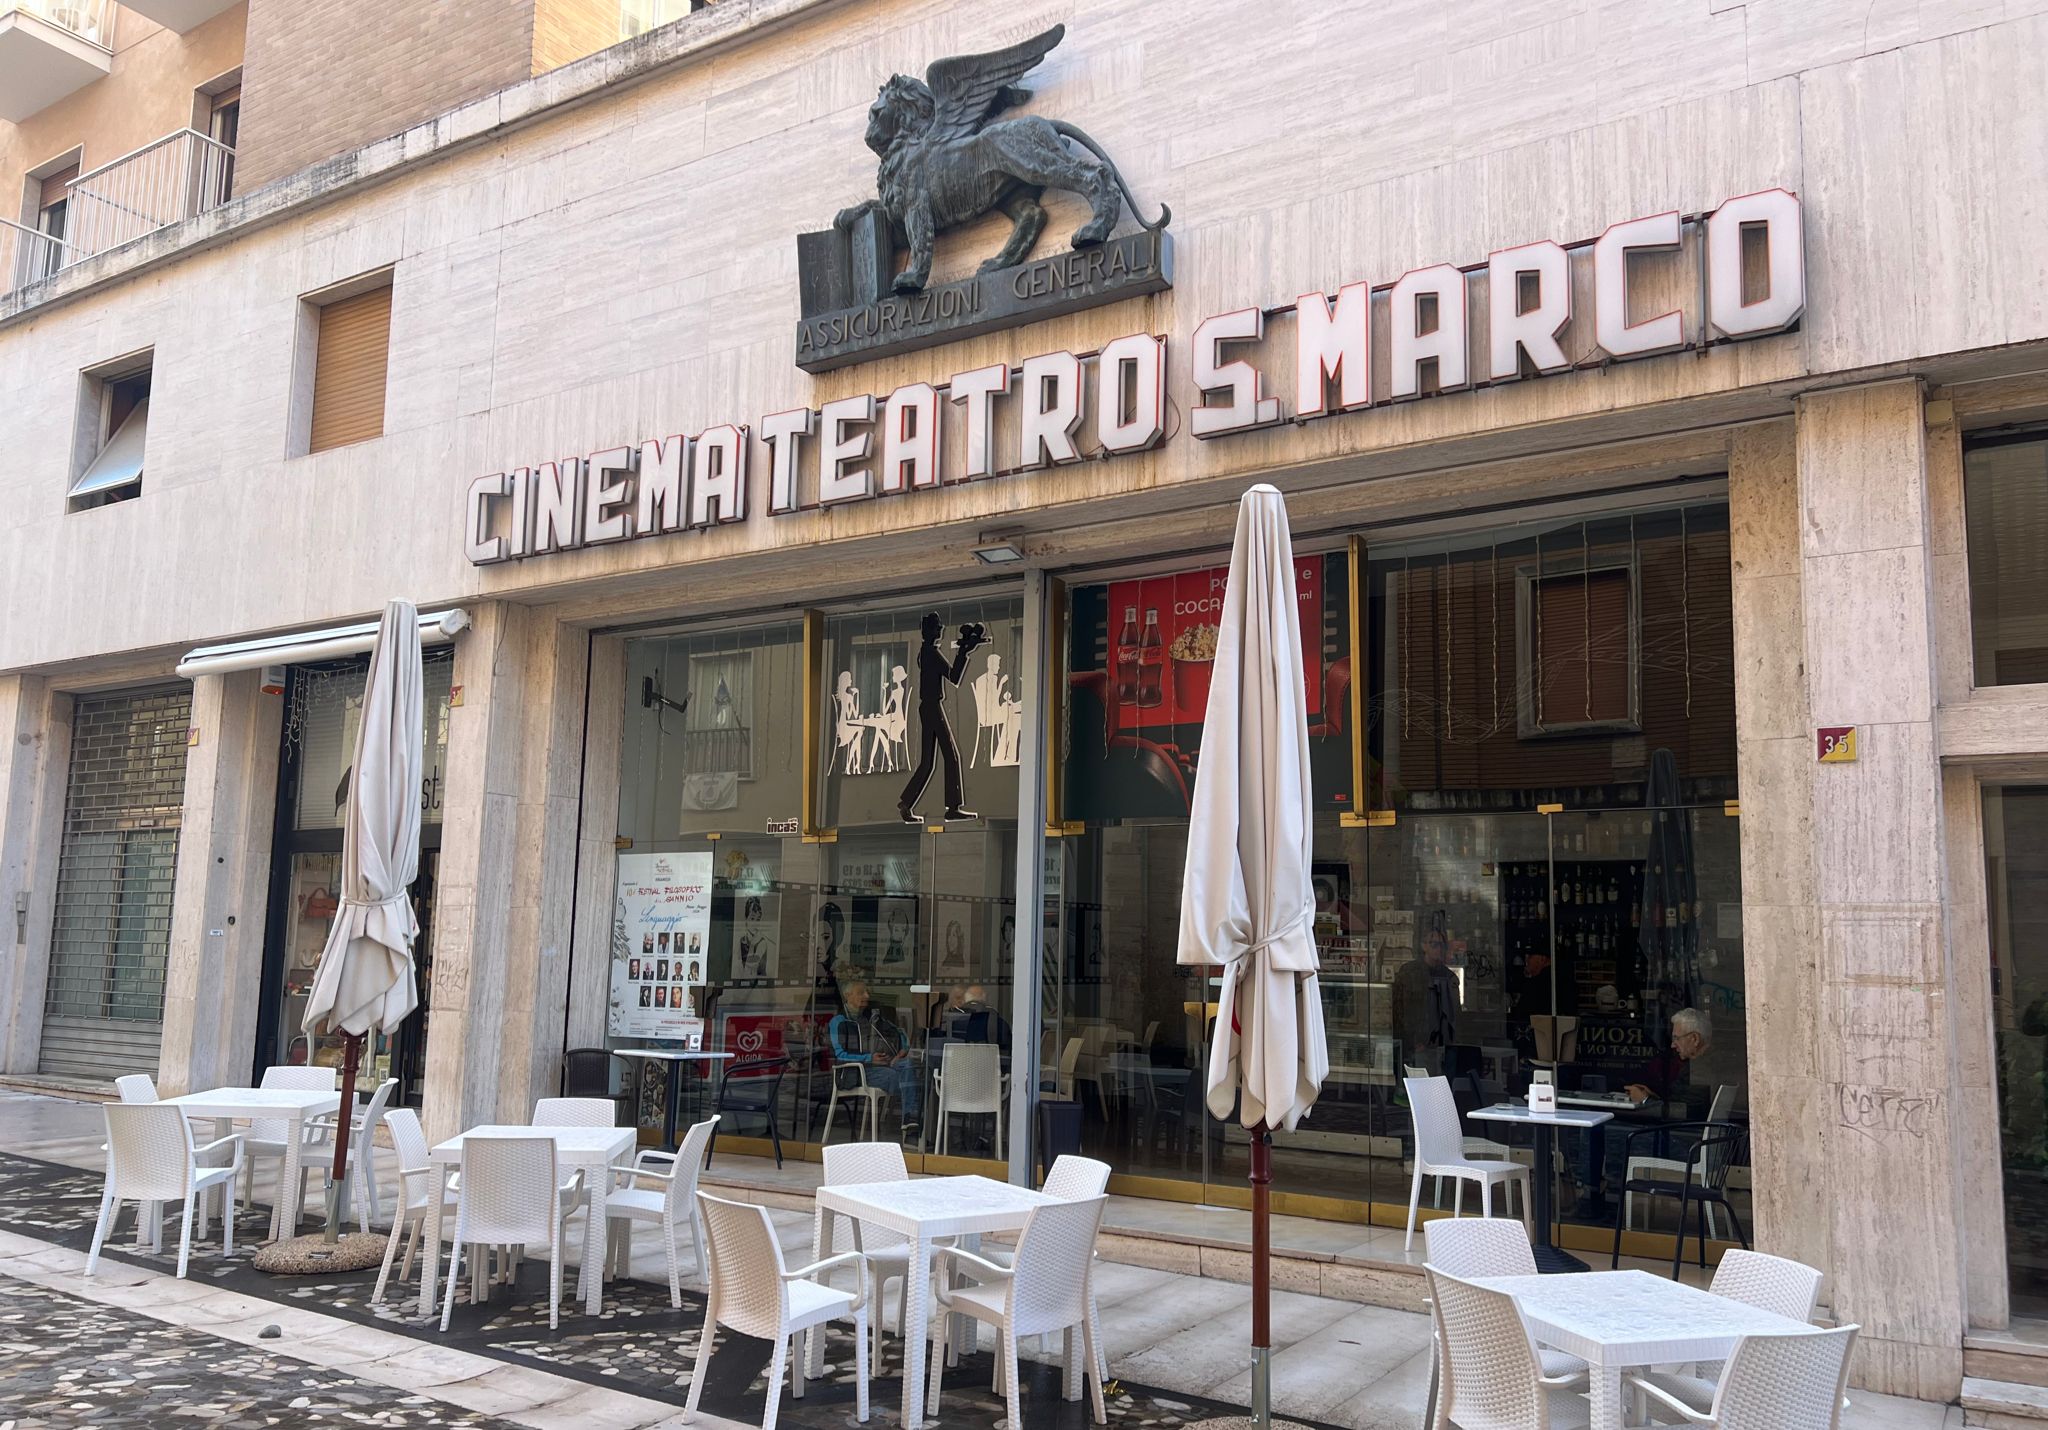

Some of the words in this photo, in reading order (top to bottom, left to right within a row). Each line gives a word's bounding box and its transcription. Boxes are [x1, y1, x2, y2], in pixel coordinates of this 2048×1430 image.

[800, 279, 980, 353] ASSICURAZIONI
[1012, 236, 1157, 299] GENERALI
[464, 425, 747, 564] CINEMA
[761, 332, 1167, 513] TEATRO
[1297, 188, 1806, 417] MARCO
[1303, 569, 1313, 580] e
[1825, 735, 1849, 753] 35
[421, 765, 440, 810] st
[767, 817, 798, 834] incas
[735, 1054, 763, 1064] ALGIDA
